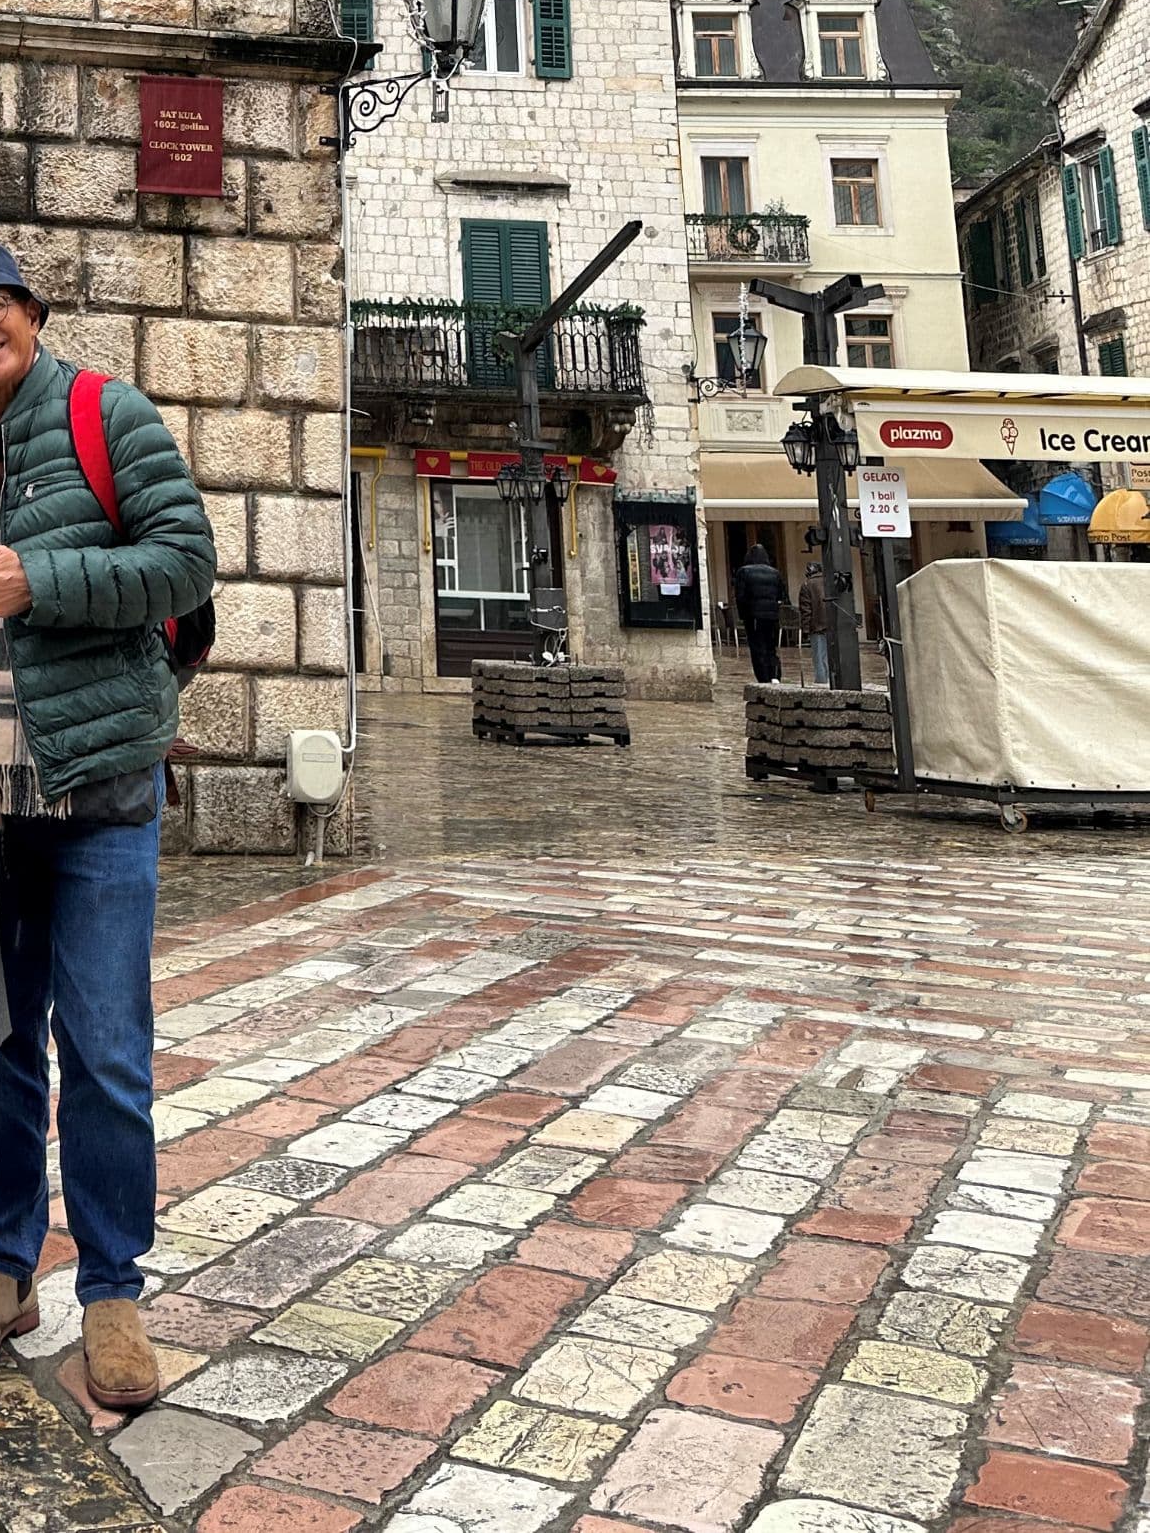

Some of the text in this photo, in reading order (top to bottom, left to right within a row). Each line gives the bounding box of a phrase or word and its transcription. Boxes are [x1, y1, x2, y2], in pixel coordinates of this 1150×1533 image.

[160, 110, 202, 120] SAT KULA
[180, 122, 209, 131] godina
[149, 141, 213, 151] CLOCK TOWER
[890, 426, 942, 443] plazma
[1039, 427, 1076, 451] Ice
[863, 472, 900, 482] GELATO
[871, 491, 896, 501] 1 ball
[869, 504, 890, 514] 2.20
[893, 504, 900, 514] €
